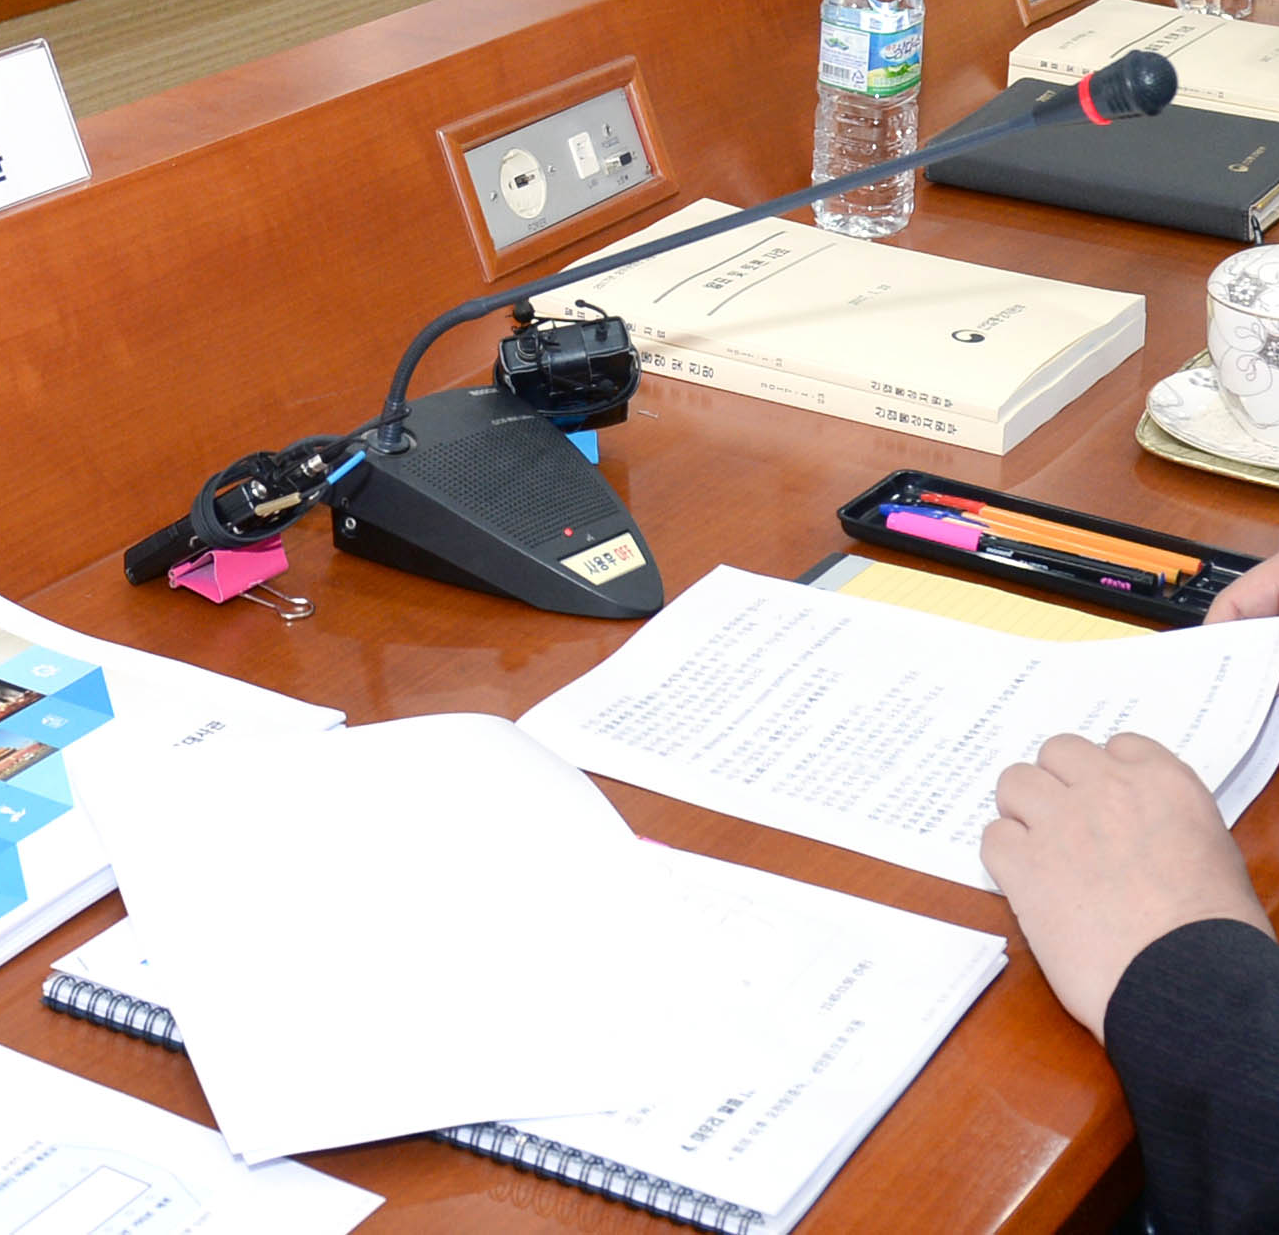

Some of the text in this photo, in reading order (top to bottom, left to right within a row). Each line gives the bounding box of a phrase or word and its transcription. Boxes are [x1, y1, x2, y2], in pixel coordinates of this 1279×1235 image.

[875, 406, 958, 435] 산업통상자원부
[583, 544, 635, 575] 사용후 OFF
